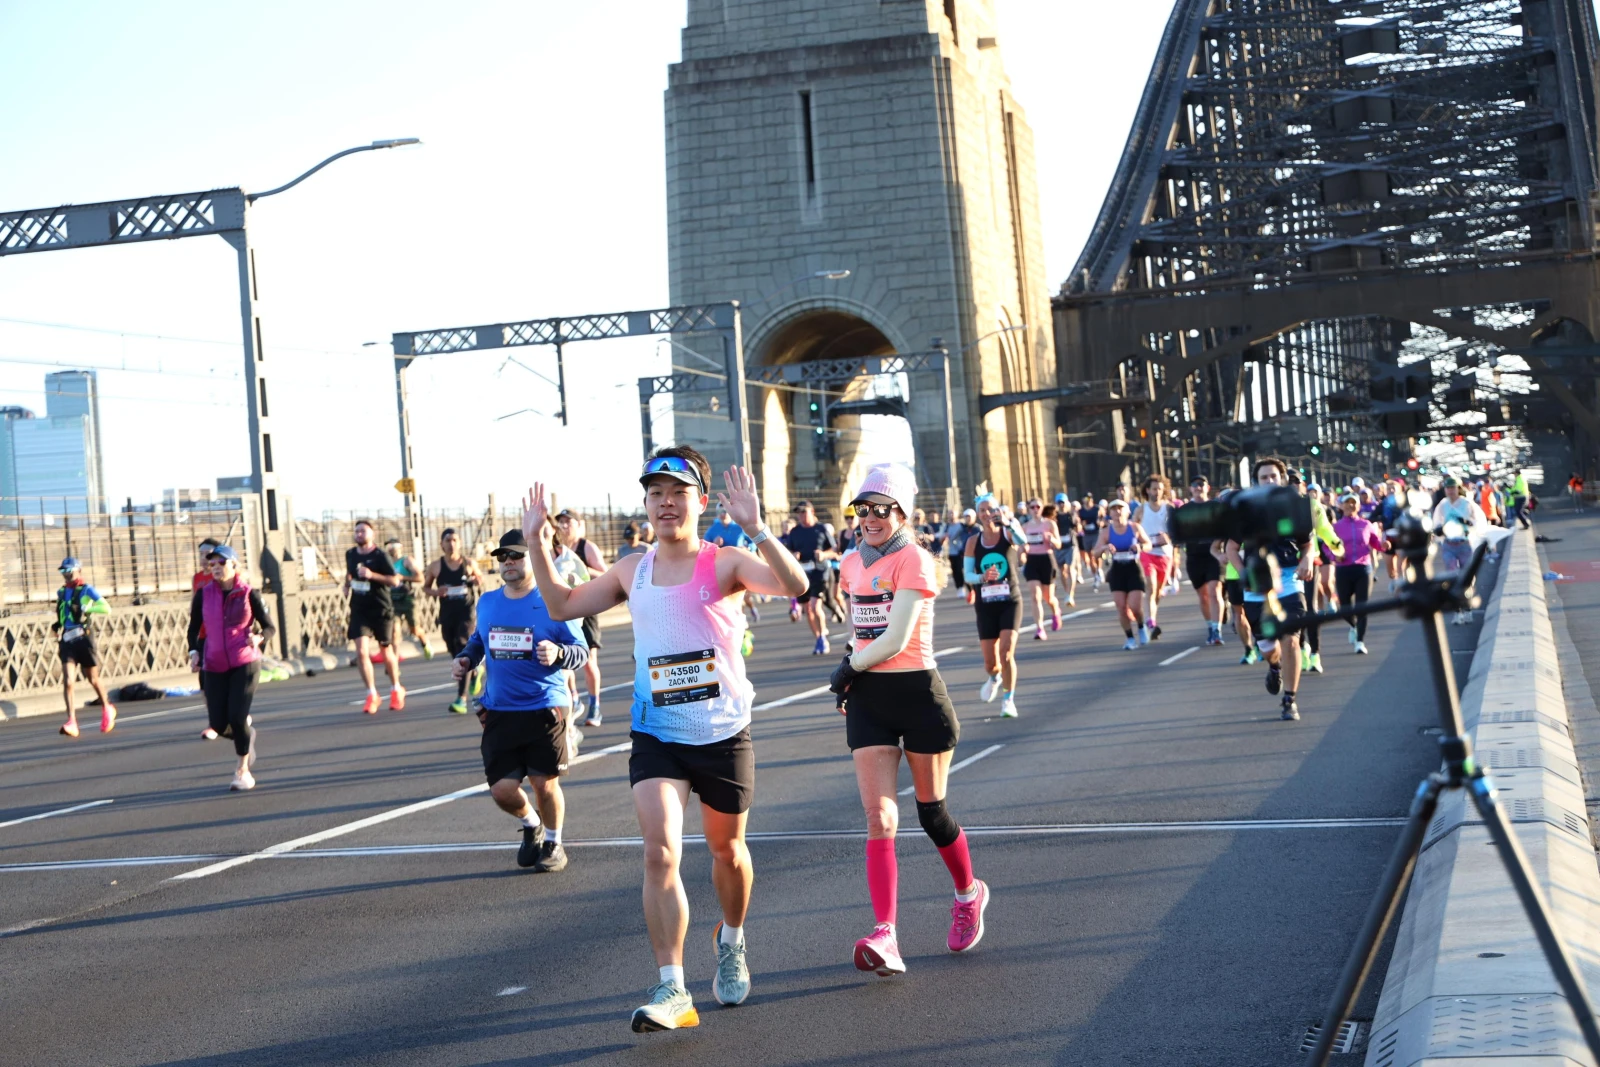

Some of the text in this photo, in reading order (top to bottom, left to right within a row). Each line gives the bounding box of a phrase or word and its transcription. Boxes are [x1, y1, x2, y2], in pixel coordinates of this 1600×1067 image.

[664, 665, 700, 677] D43580
[668, 675, 698, 687] ZACK WU
